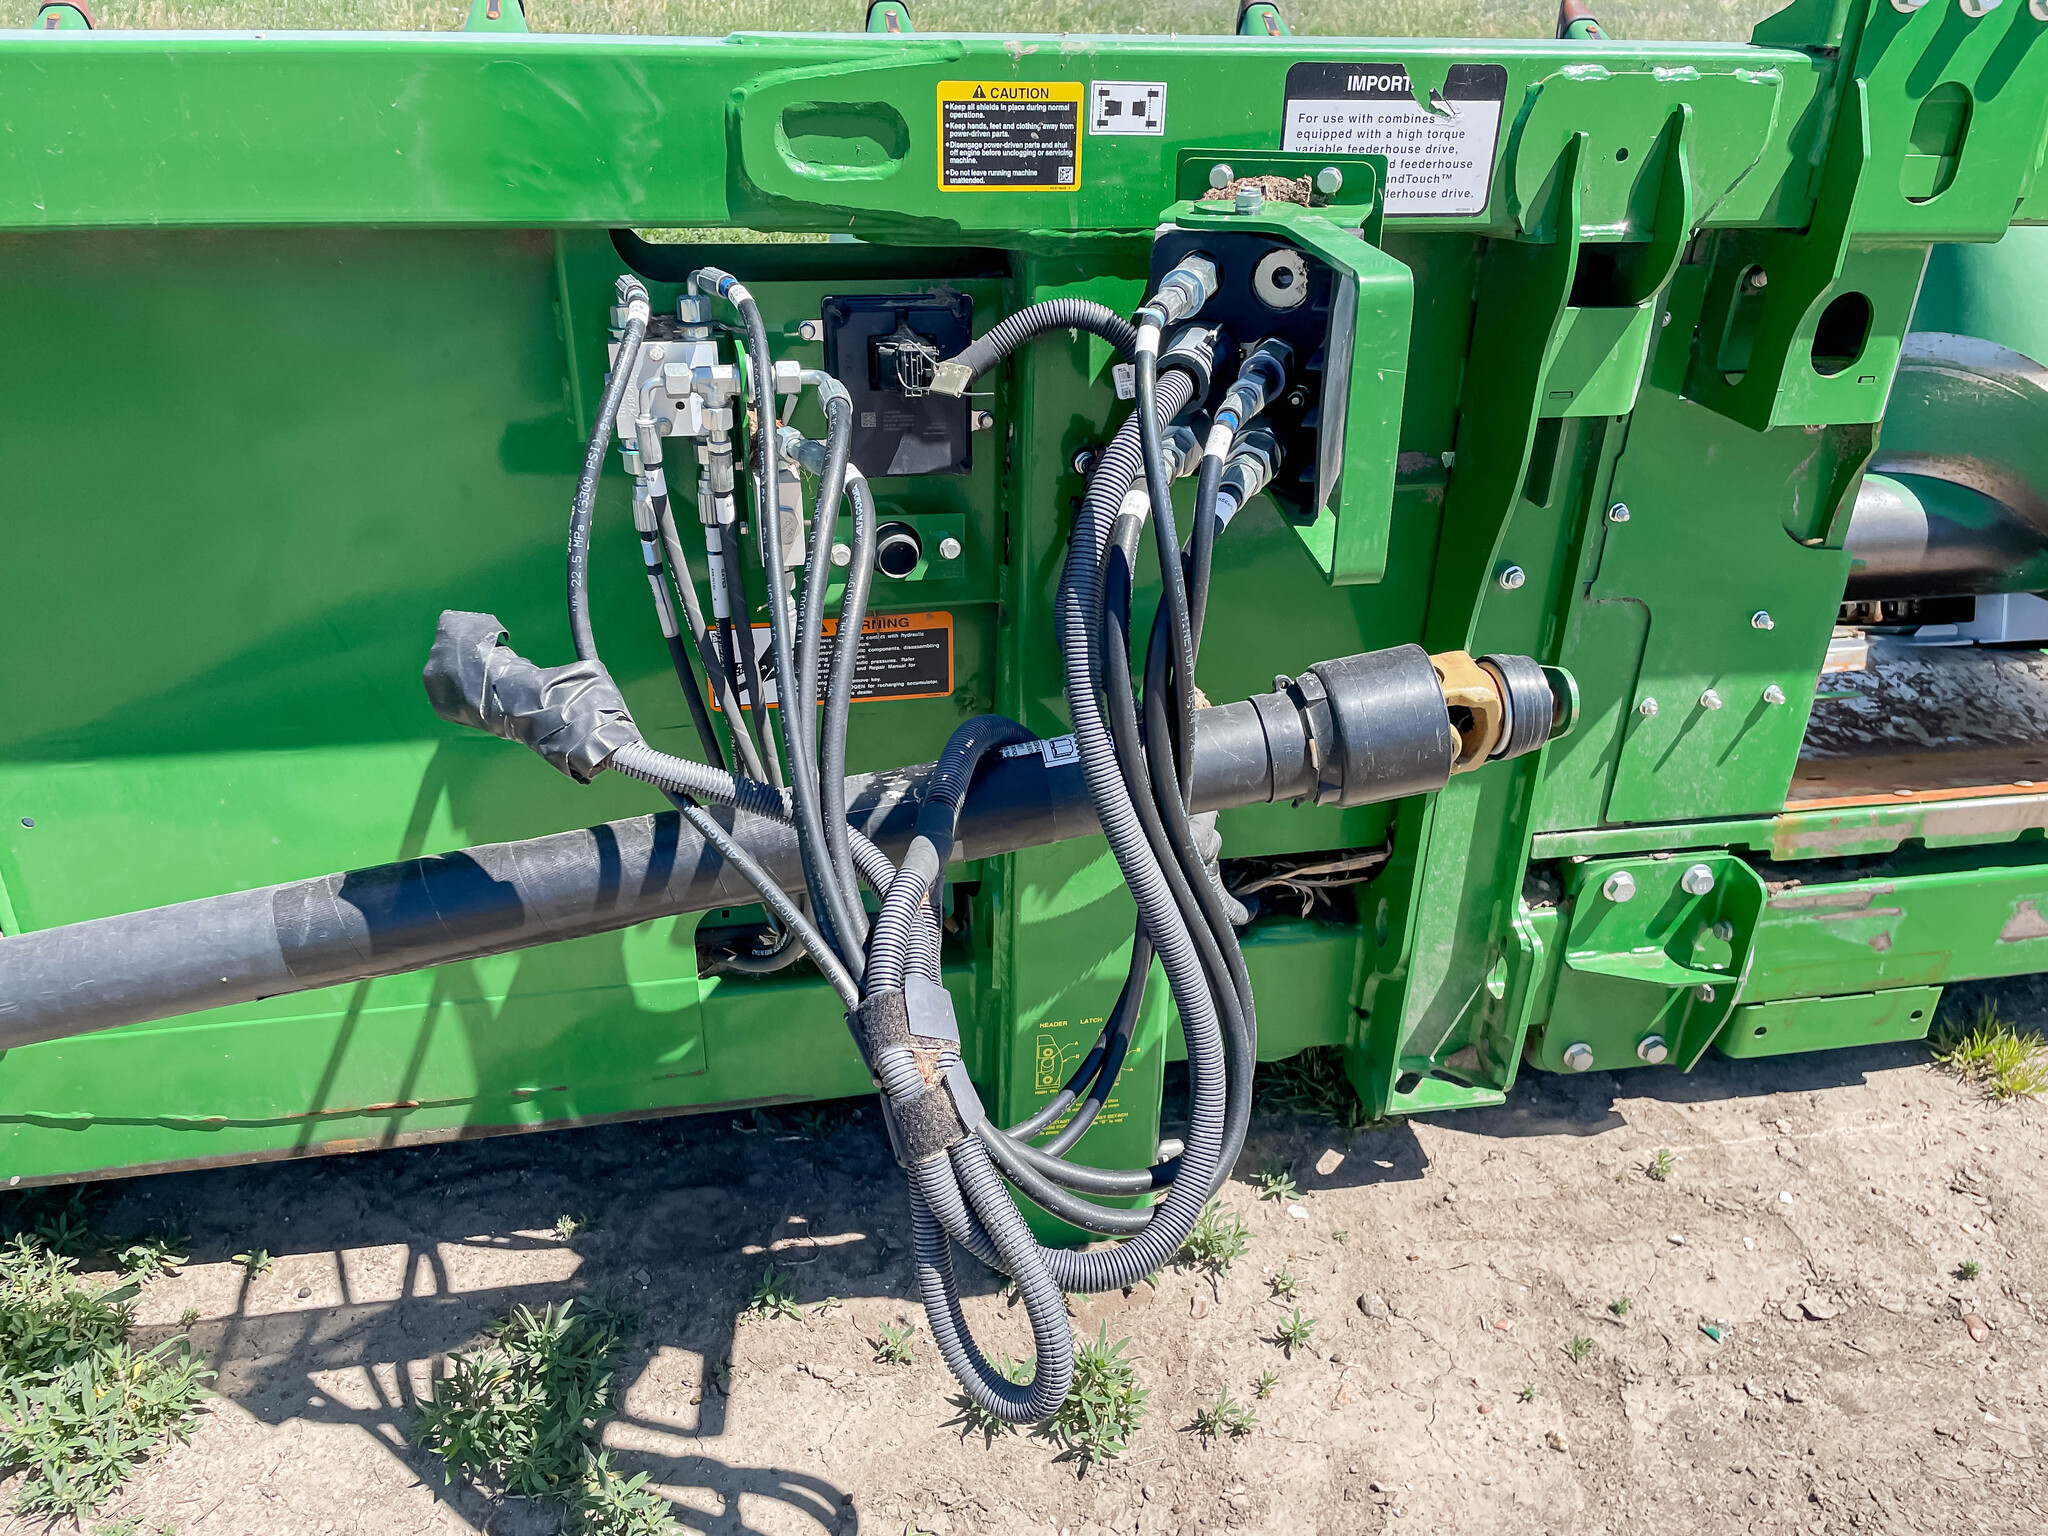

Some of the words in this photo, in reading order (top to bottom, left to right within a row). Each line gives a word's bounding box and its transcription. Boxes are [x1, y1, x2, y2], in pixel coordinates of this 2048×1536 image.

[990, 88, 1049, 99] CAUTION
[950, 103, 966, 111] Keep
[1008, 104, 1025, 112] place
[1026, 104, 1046, 112] during
[950, 111, 985, 119] operations.
[1298, 113, 1318, 123] For
[1348, 114, 1373, 123] with
[1378, 114, 1436, 123] combines
[950, 122, 966, 130] Keep
[968, 122, 988, 130] hands,
[1016, 122, 1041, 131] clothing
[1060, 122, 1074, 130] from
[950, 130, 990, 138] power-driven
[1296, 129, 1352, 141] equipped
[1357, 129, 1381, 138] with
[1397, 129, 1422, 141] high
[1427, 130, 1465, 141] torque
[950, 141, 982, 149] Disengage
[984, 141, 1023, 149] power-driven
[1296, 144, 1343, 153] variable
[1348, 144, 1421, 154] feederhouse
[1425, 144, 1458, 154] drive,
[1002, 149, 1036, 157] unclogging
[1045, 149, 1073, 157] servicing
[950, 156, 978, 164] machine.
[1400, 159, 1473, 169] feederhouse
[988, 169, 1011, 177] running
[1386, 174, 1452, 183] ndTouch™
[1441, 189, 1474, 198] drive.
[600, 379, 622, 431] exceeds
[586, 438, 602, 469] PSI)
[578, 476, 593, 514] (3300
[573, 524, 585, 548] MPa
[571, 555, 582, 587] 22.5
[862, 617, 909, 630] RNING
[828, 967, 840, 984] IN
[1040, 1020, 1068, 1028] HEADER
